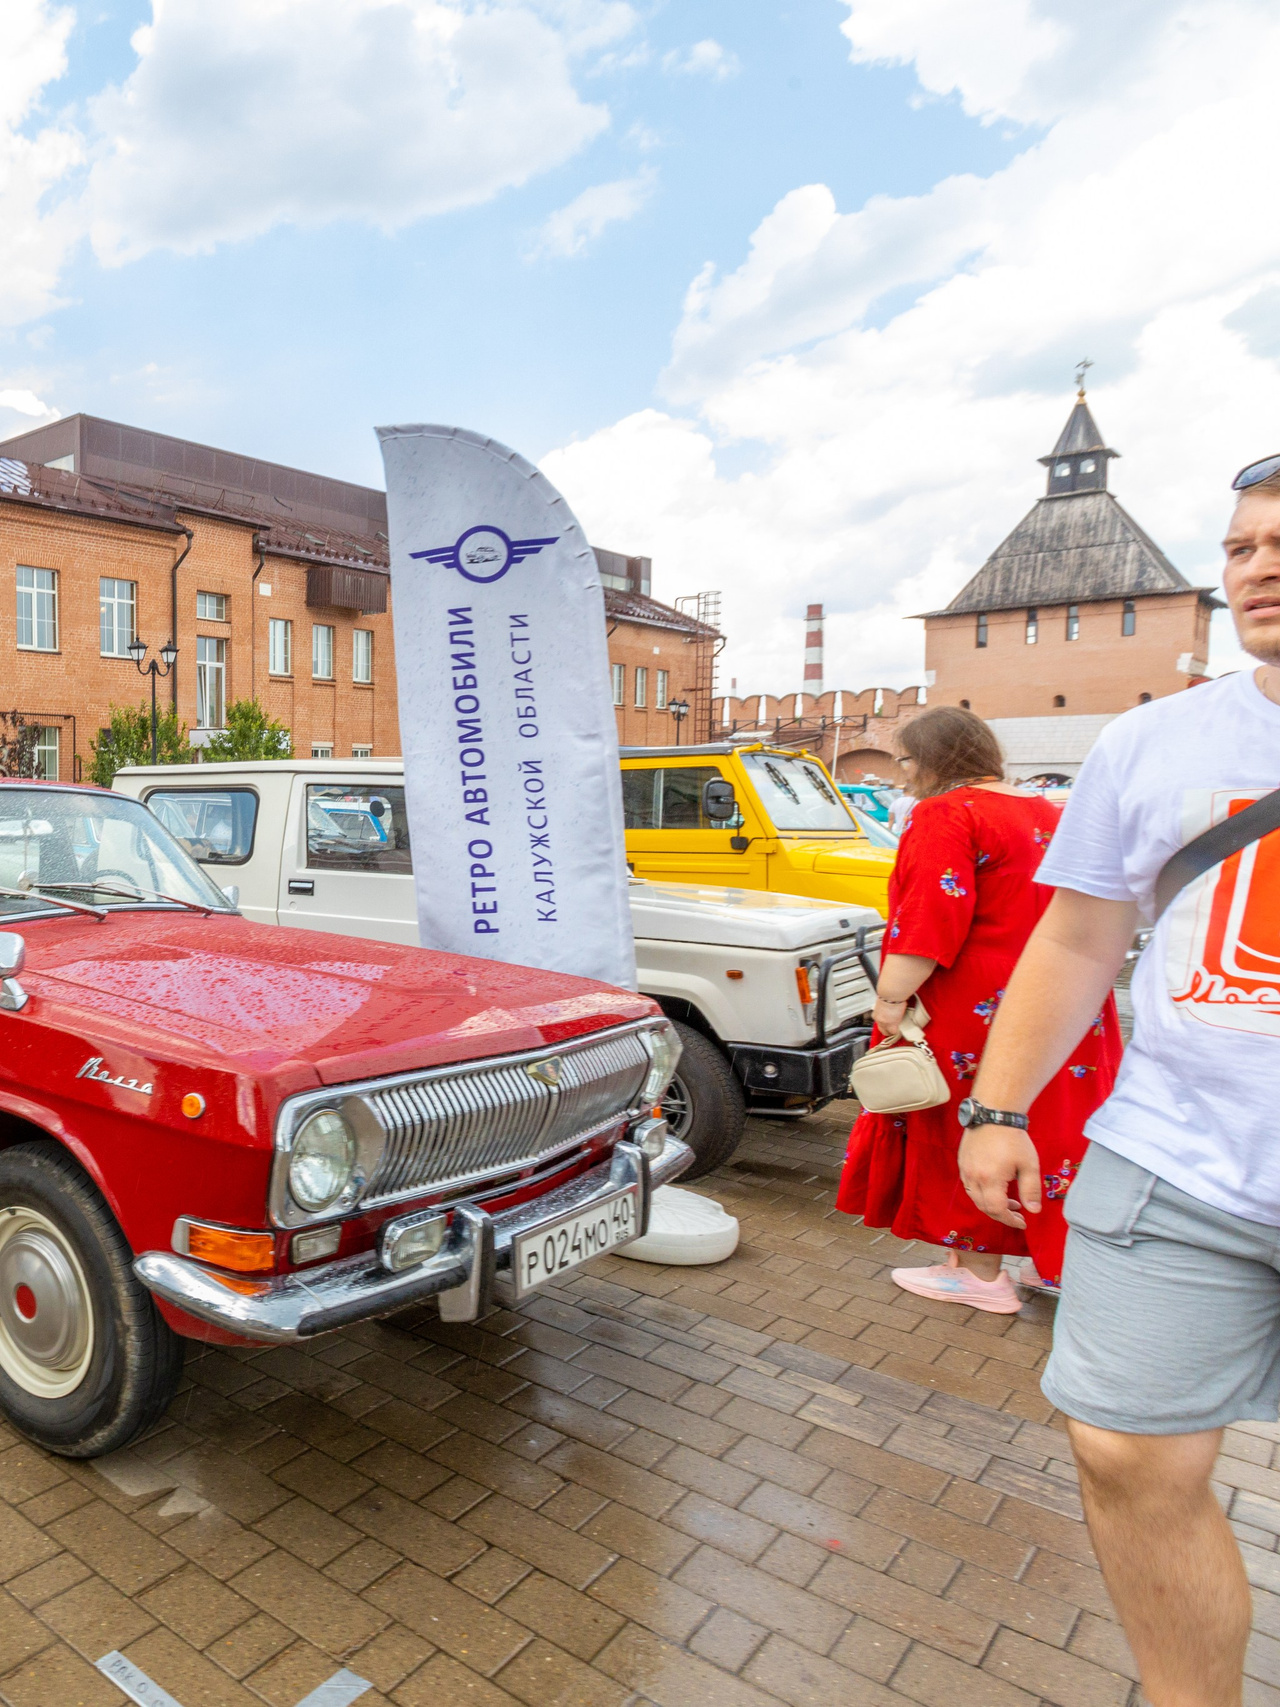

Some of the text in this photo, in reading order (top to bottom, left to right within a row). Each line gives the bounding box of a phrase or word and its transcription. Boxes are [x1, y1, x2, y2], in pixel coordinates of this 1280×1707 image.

[447, 606, 500, 934] РЕТРО АВТОМОБИЛИ
[508, 613, 558, 922] КАЛУЖСКОЙ ОБЛАСТИ
[75, 1056, 154, 1096] Волга
